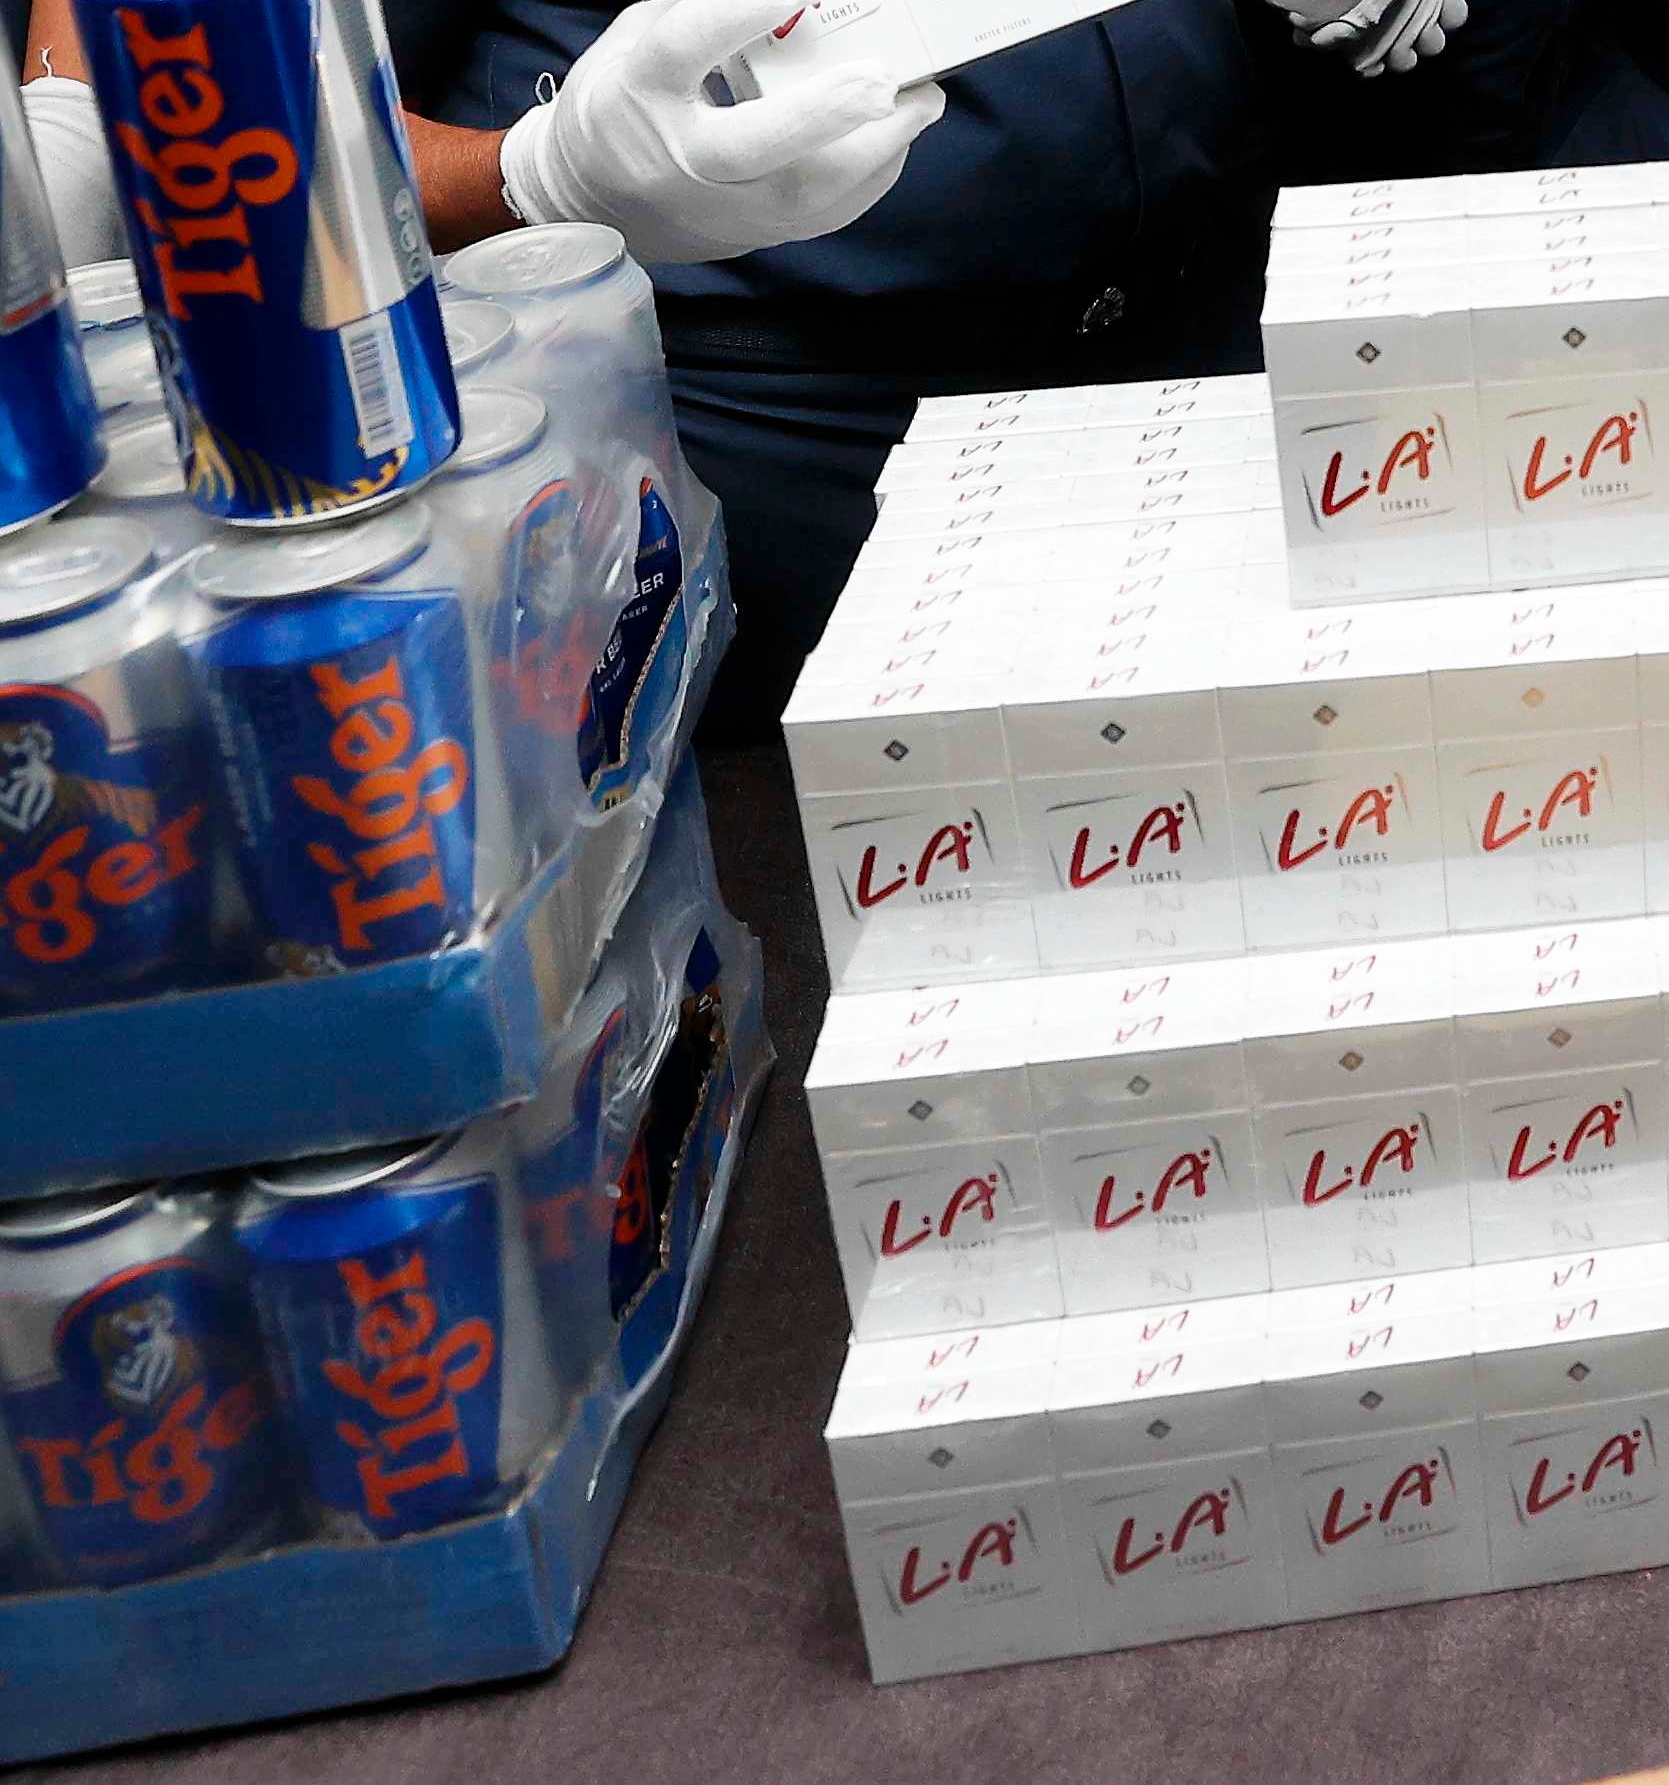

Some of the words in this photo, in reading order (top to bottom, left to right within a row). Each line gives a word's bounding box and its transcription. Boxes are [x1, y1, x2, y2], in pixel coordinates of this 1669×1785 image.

[819, 1, 861, 25] LIGHTS
[114, 8, 299, 320] Tiger
[0, 804, 203, 963] ger
[292, 658, 470, 950] Tiger
[321, 1251, 495, 1517] Tiger
